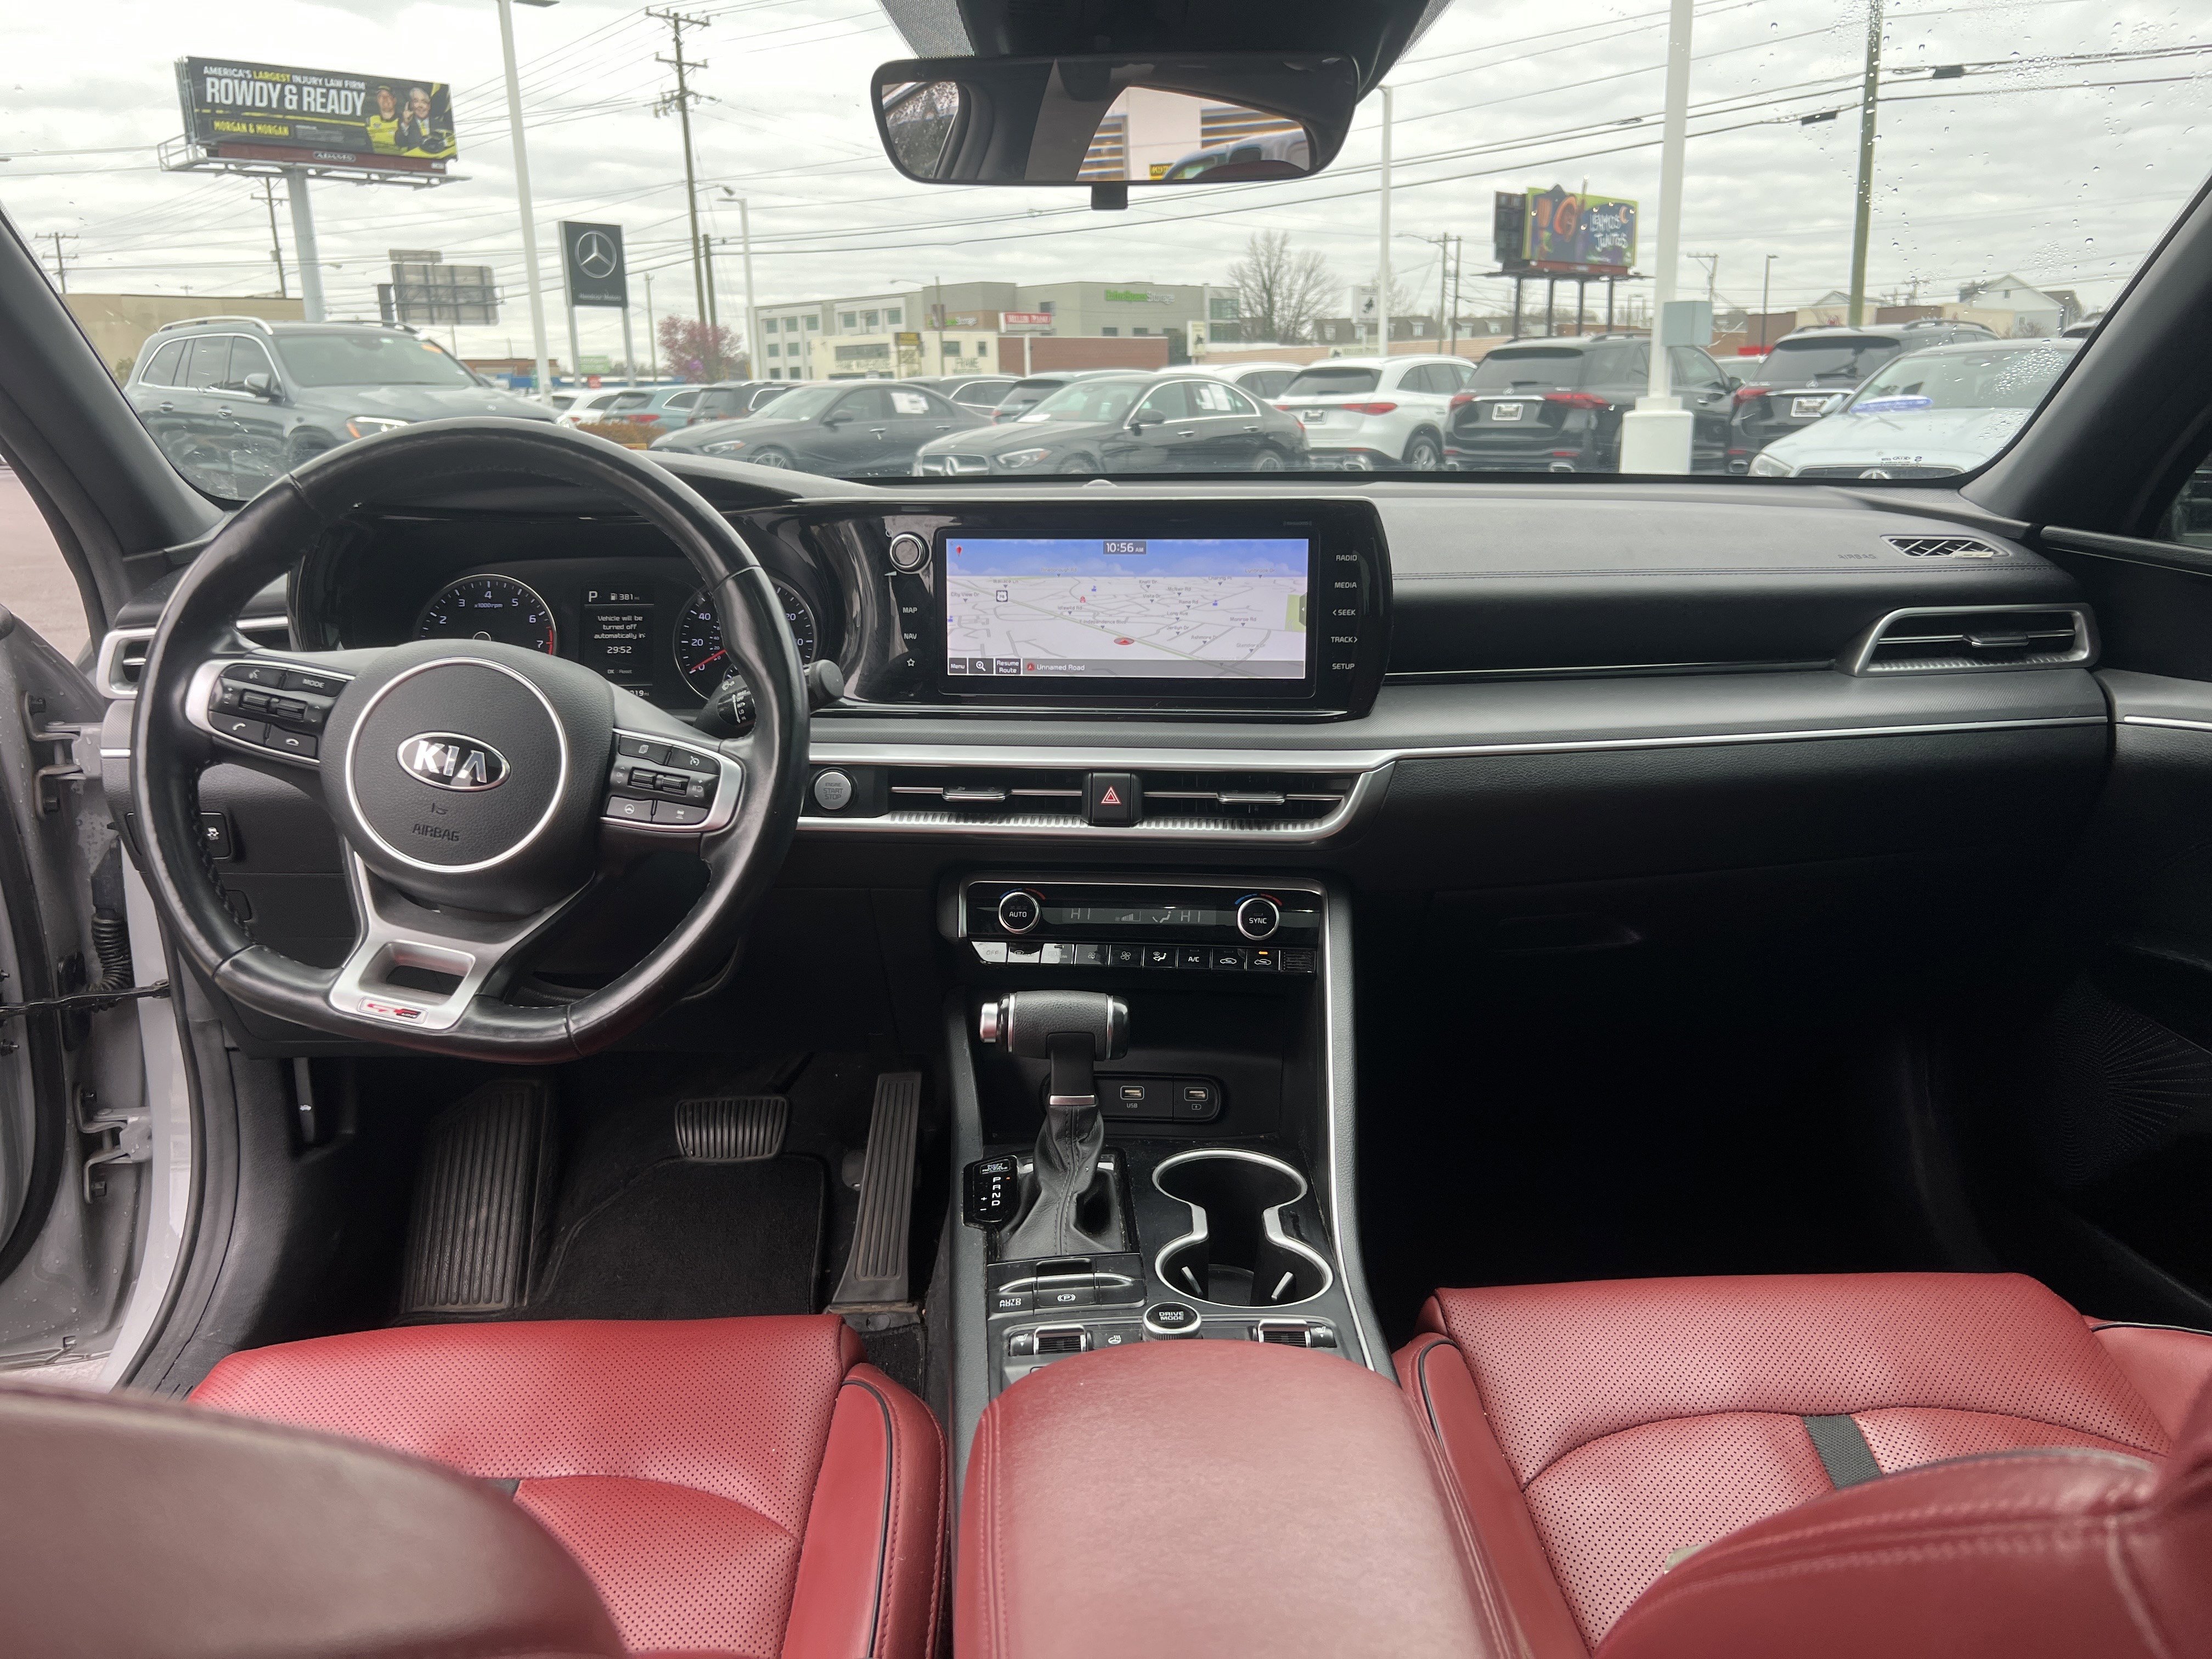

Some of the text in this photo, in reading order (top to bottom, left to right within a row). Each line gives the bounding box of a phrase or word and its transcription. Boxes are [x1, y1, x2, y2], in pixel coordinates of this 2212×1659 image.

[204, 66, 365, 90] AMERICA'S LARGEST INJURY LAW FIRM
[206, 77, 366, 116] ROWDY & READY
[213, 120, 247, 133] MORGAN
[249, 123, 255, 133] &
[256, 124, 289, 136] MORGAN
[1106, 543, 1133, 552] 10:56
[484, 591, 492, 599] 4
[589, 591, 597, 602] P
[458, 599, 465, 607] 3
[512, 599, 518, 607] 5
[439, 616, 447, 624] 2
[529, 615, 536, 623] 6
[537, 640, 543, 648] 7
[303, 678, 325, 689] MODE
[414, 740, 487, 783] KIA
[412, 823, 460, 841] AIRBAG
